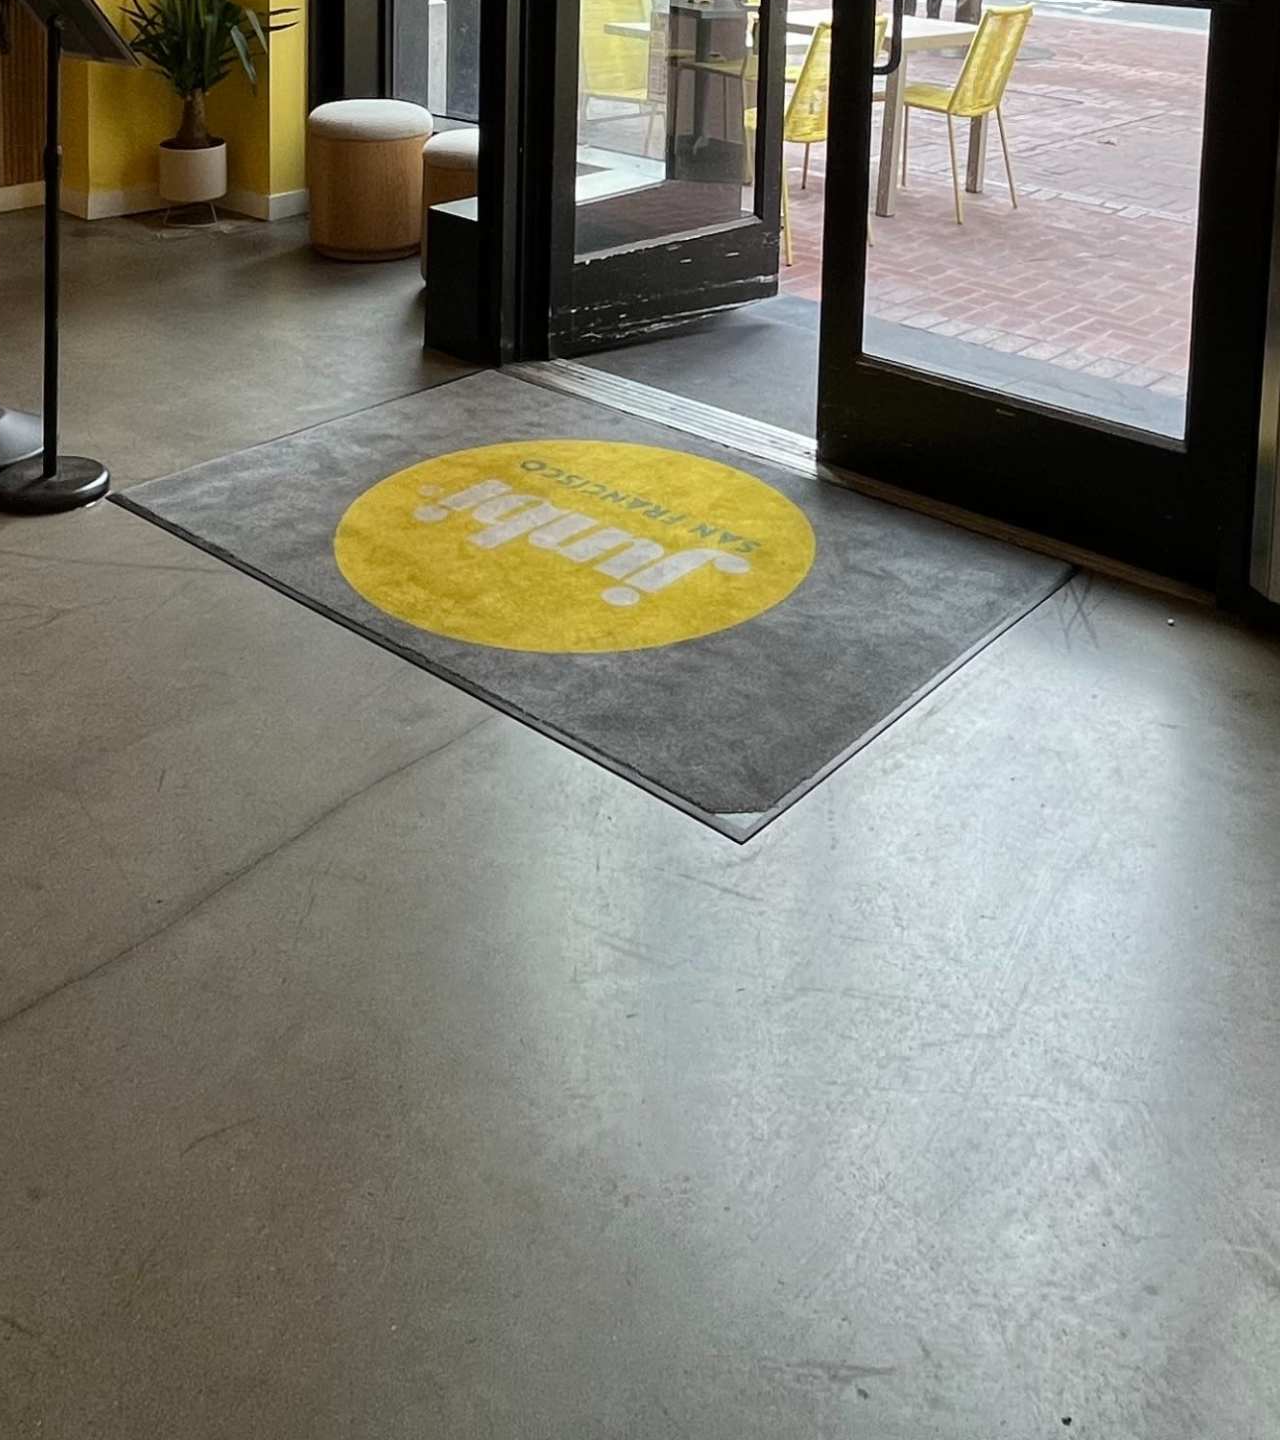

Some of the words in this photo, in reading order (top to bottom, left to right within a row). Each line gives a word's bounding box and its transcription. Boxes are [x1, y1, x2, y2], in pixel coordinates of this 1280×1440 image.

[519, 458, 687, 528] FRANCISCO
[413, 478, 751, 607] junbi
[686, 522, 762, 554] SAN
